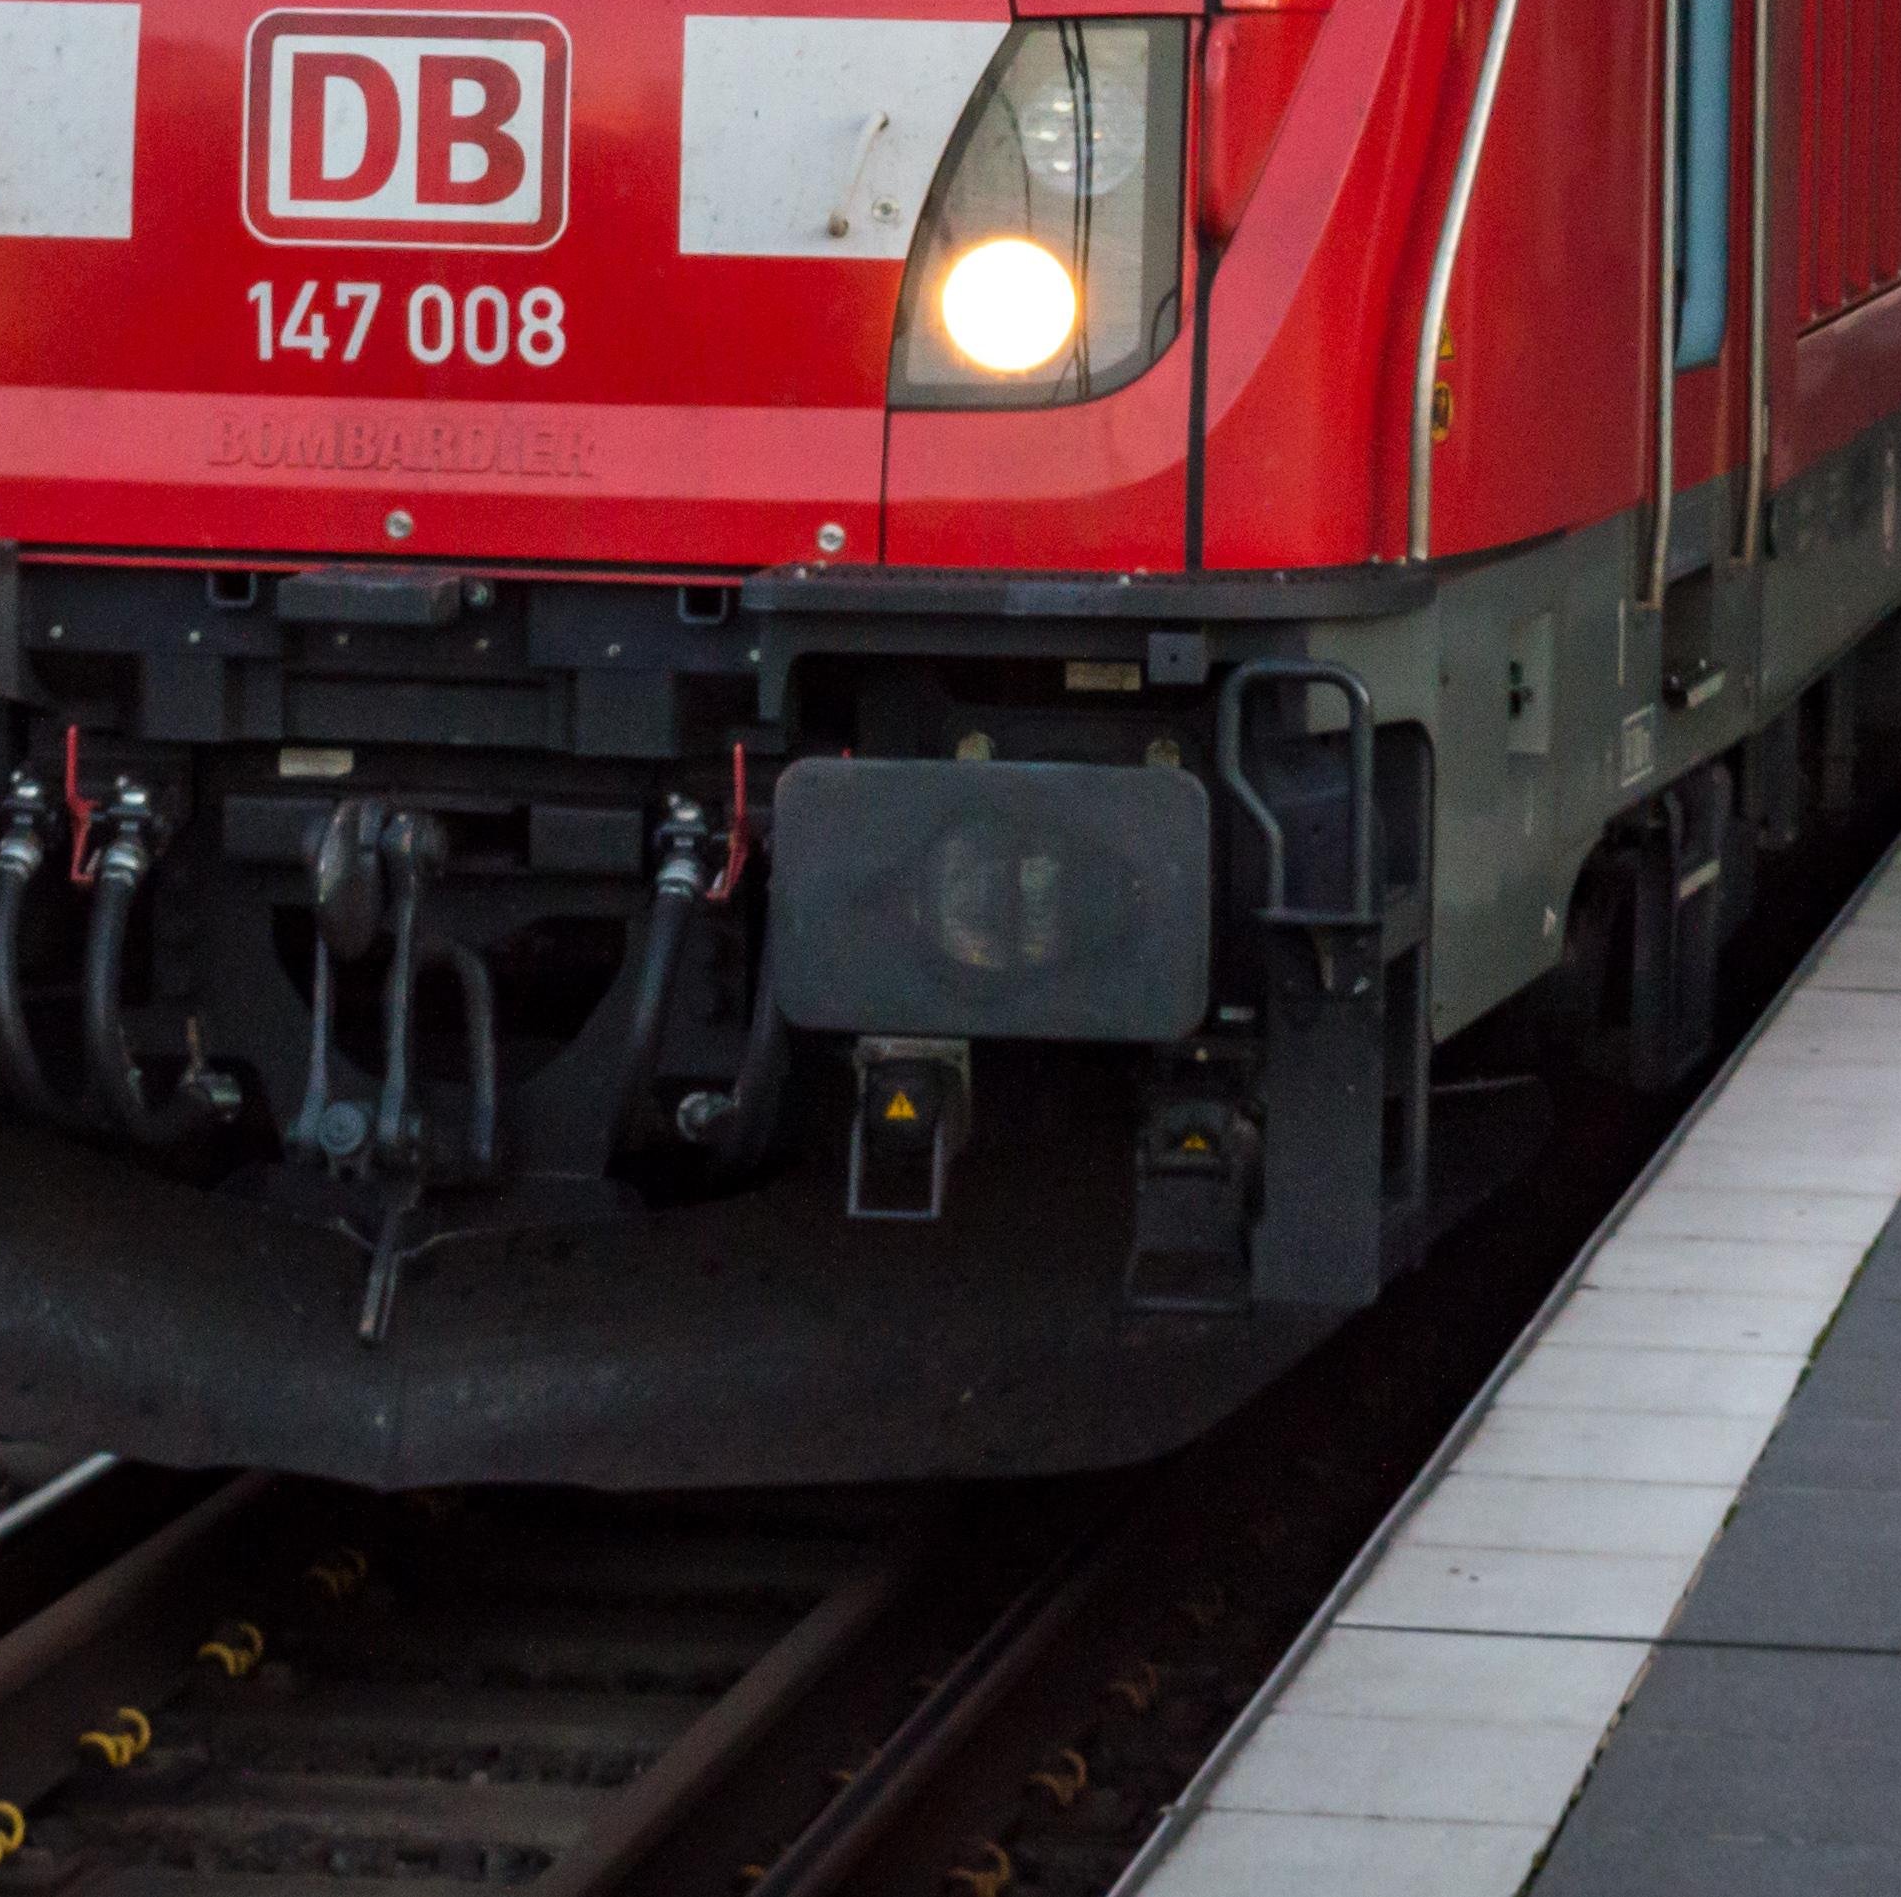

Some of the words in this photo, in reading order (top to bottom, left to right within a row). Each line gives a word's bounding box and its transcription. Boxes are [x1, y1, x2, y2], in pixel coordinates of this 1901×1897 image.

[289, 52, 527, 206] DB
[247, 280, 383, 362] 147
[407, 284, 566, 367] 008
[208, 414, 598, 476] BOMBARDIER
